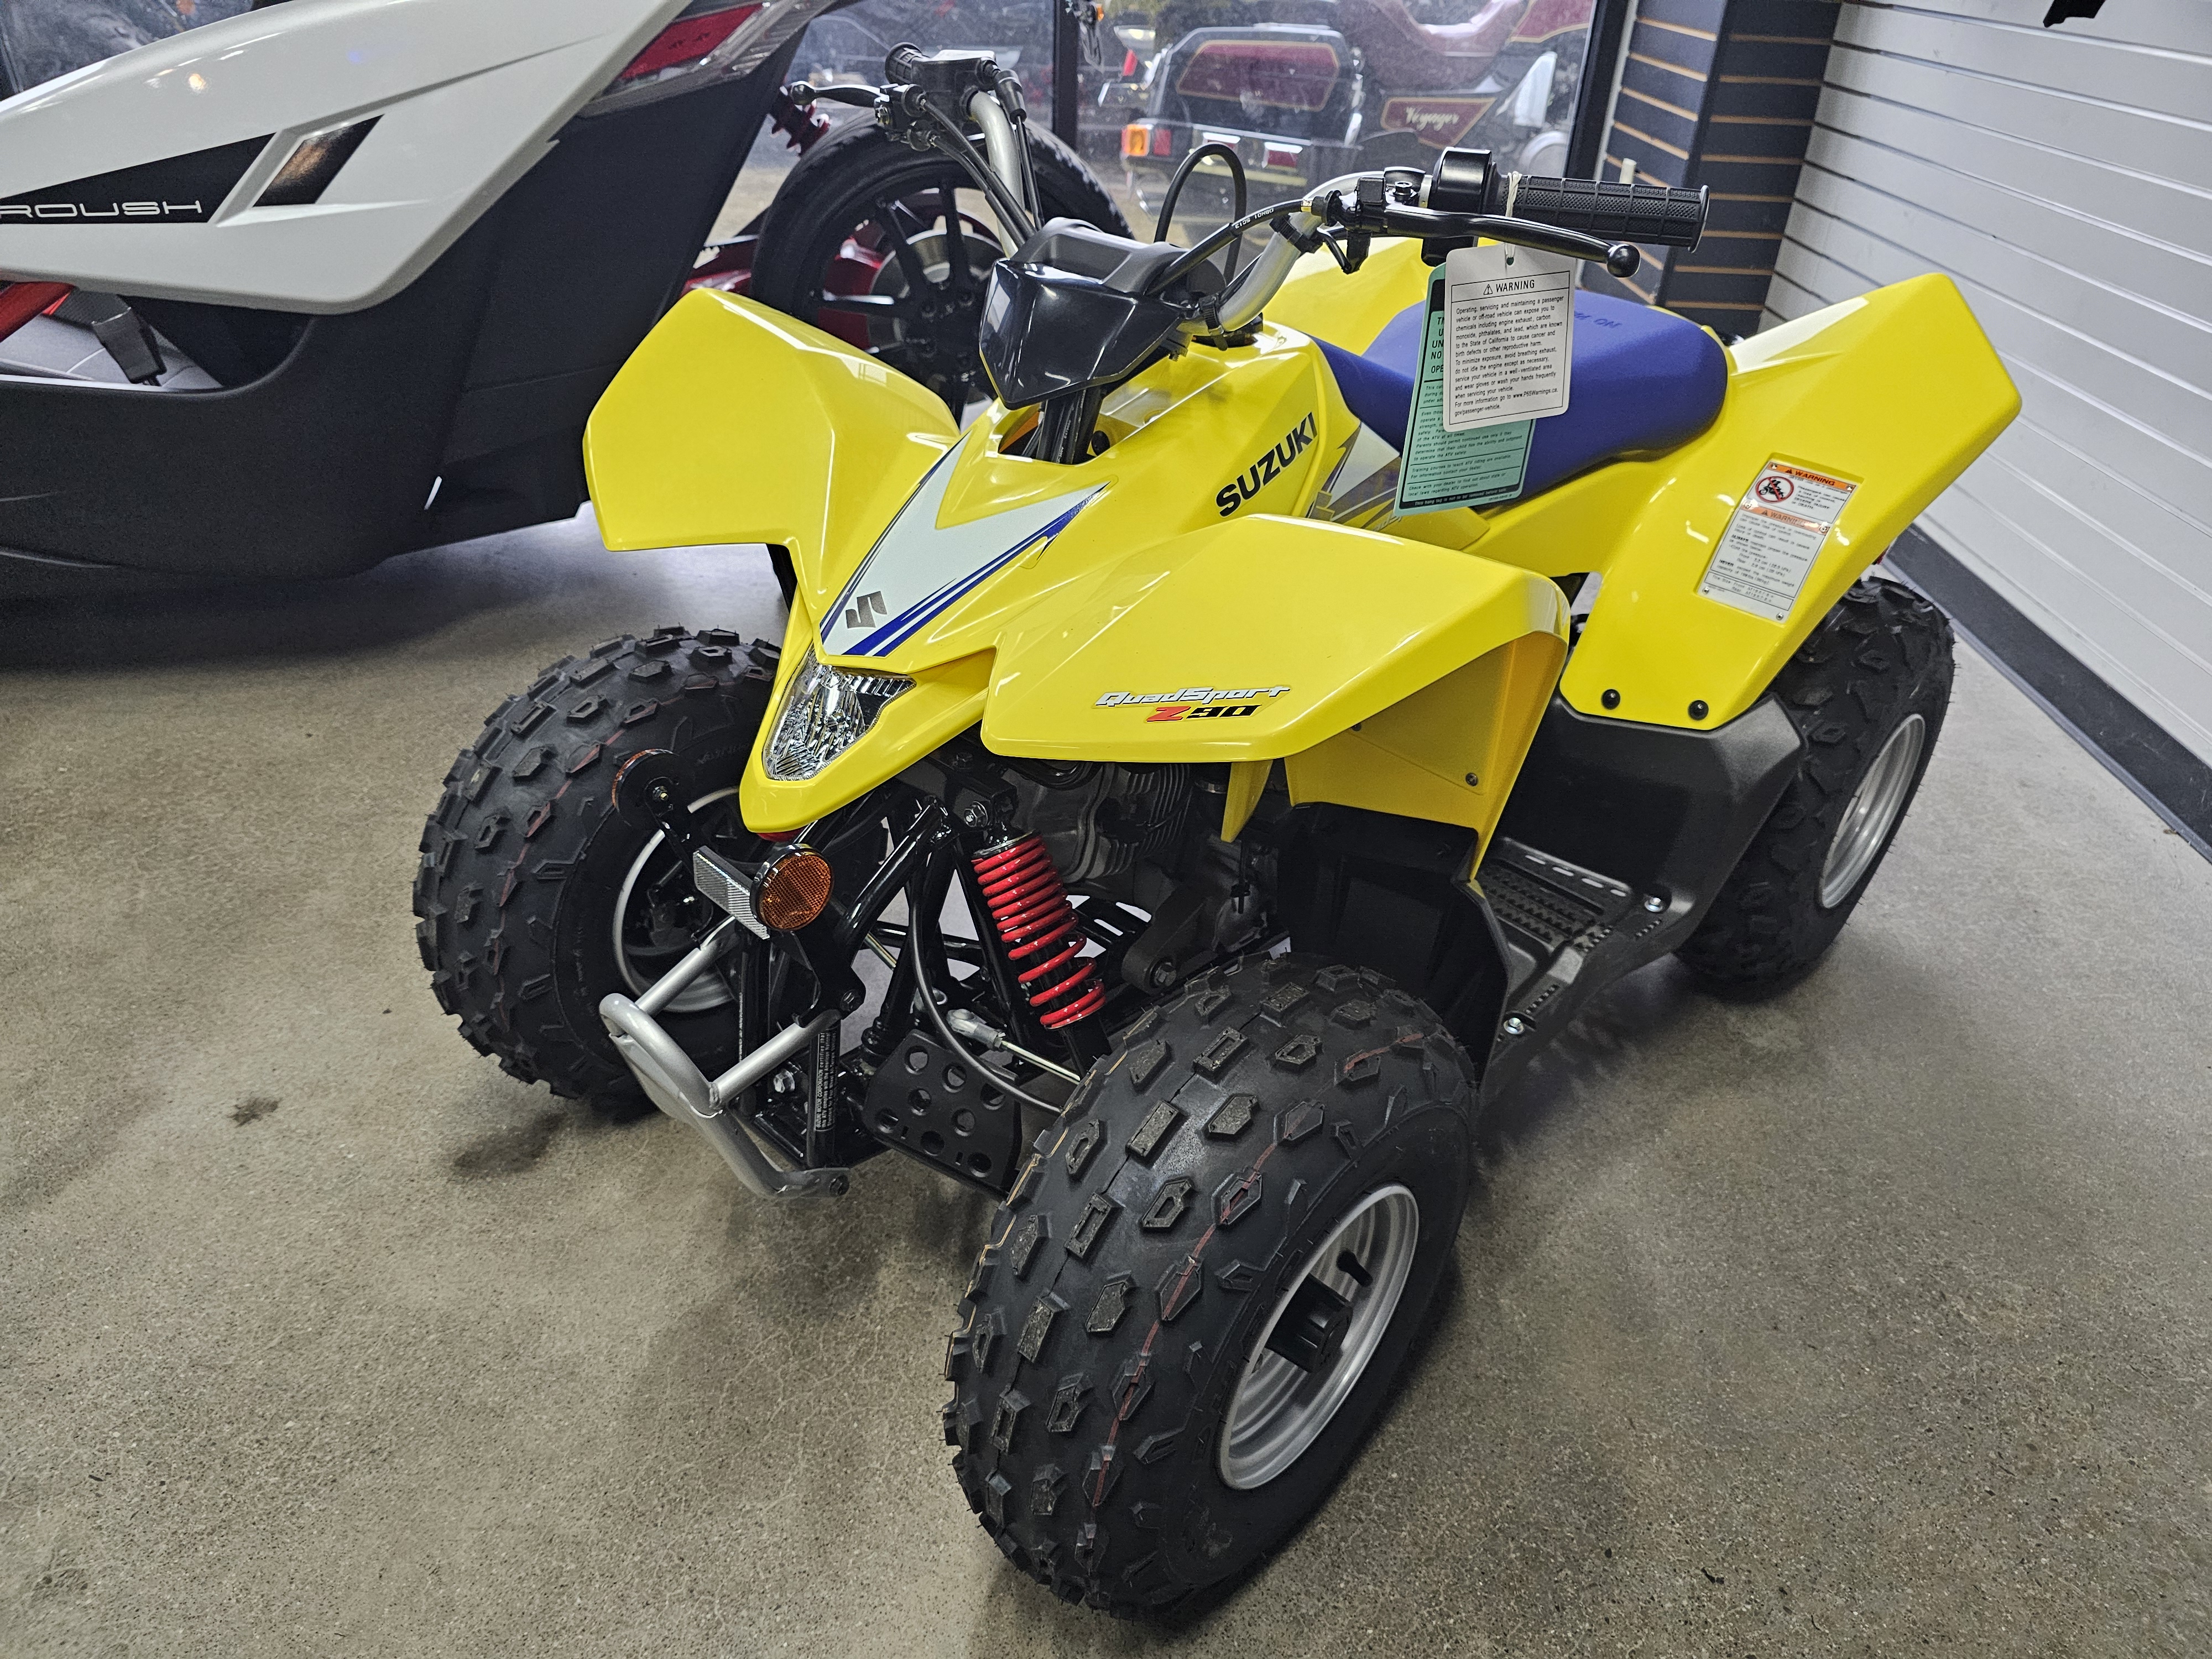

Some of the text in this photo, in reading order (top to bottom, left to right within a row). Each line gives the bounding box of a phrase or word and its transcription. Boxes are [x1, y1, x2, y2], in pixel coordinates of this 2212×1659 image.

[0, 200, 202, 218] ROUSH
[1496, 279, 1535, 293] WARNING
[1455, 306, 1478, 315] Operating,
[1541, 296, 1564, 304] passenger
[1478, 311, 1495, 320] off-road
[1455, 323, 1476, 331] chemicals
[1478, 330, 1501, 338] phthalates,
[1502, 342, 1528, 351] reproductive
[1216, 411, 1317, 517] SUZUKI
[1795, 471, 1835, 486] WARNING
[1095, 685, 1291, 707] QuadSport
[1146, 705, 1262, 722] Z90
